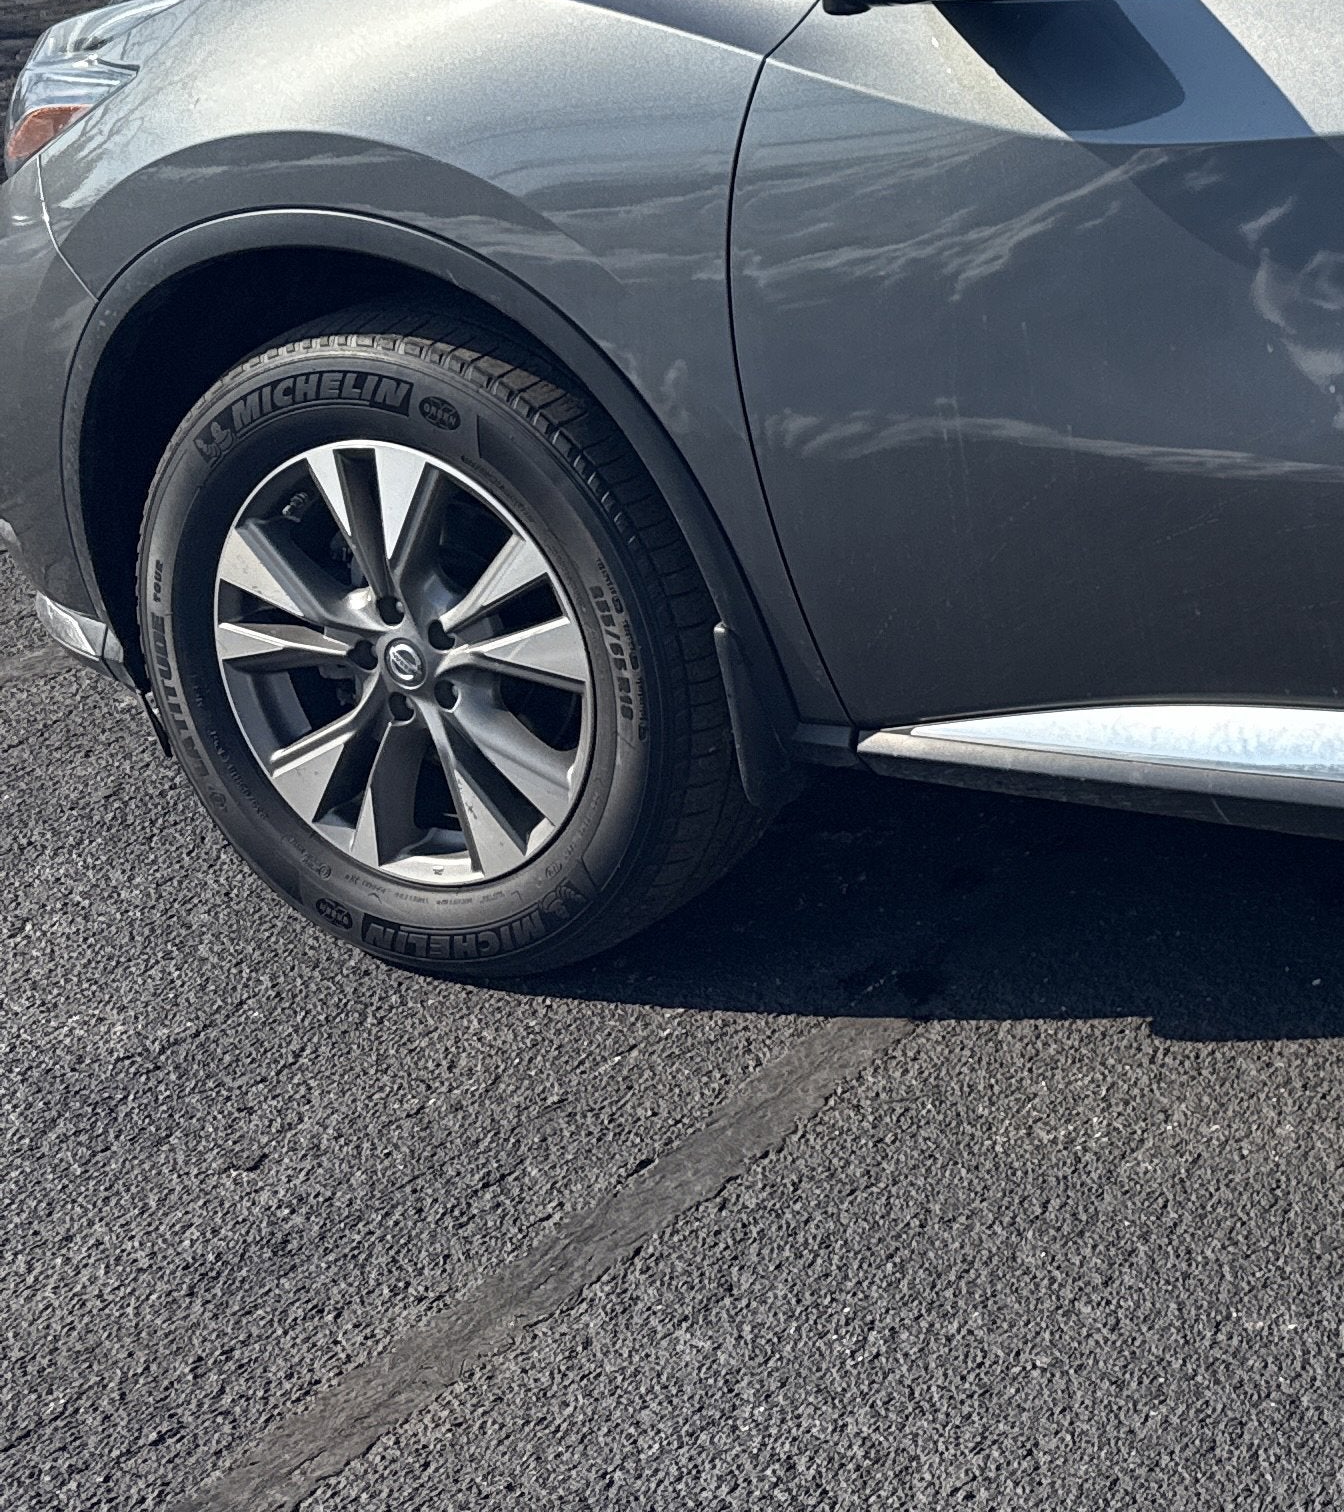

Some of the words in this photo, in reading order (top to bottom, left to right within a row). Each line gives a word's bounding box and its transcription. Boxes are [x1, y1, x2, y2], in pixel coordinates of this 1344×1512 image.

[233, 370, 411, 430] MICHELIN
[152, 559, 164, 603] TOUR
[151, 612, 209, 777] LATITUDE
[368, 910, 546, 960] MICHELIN
